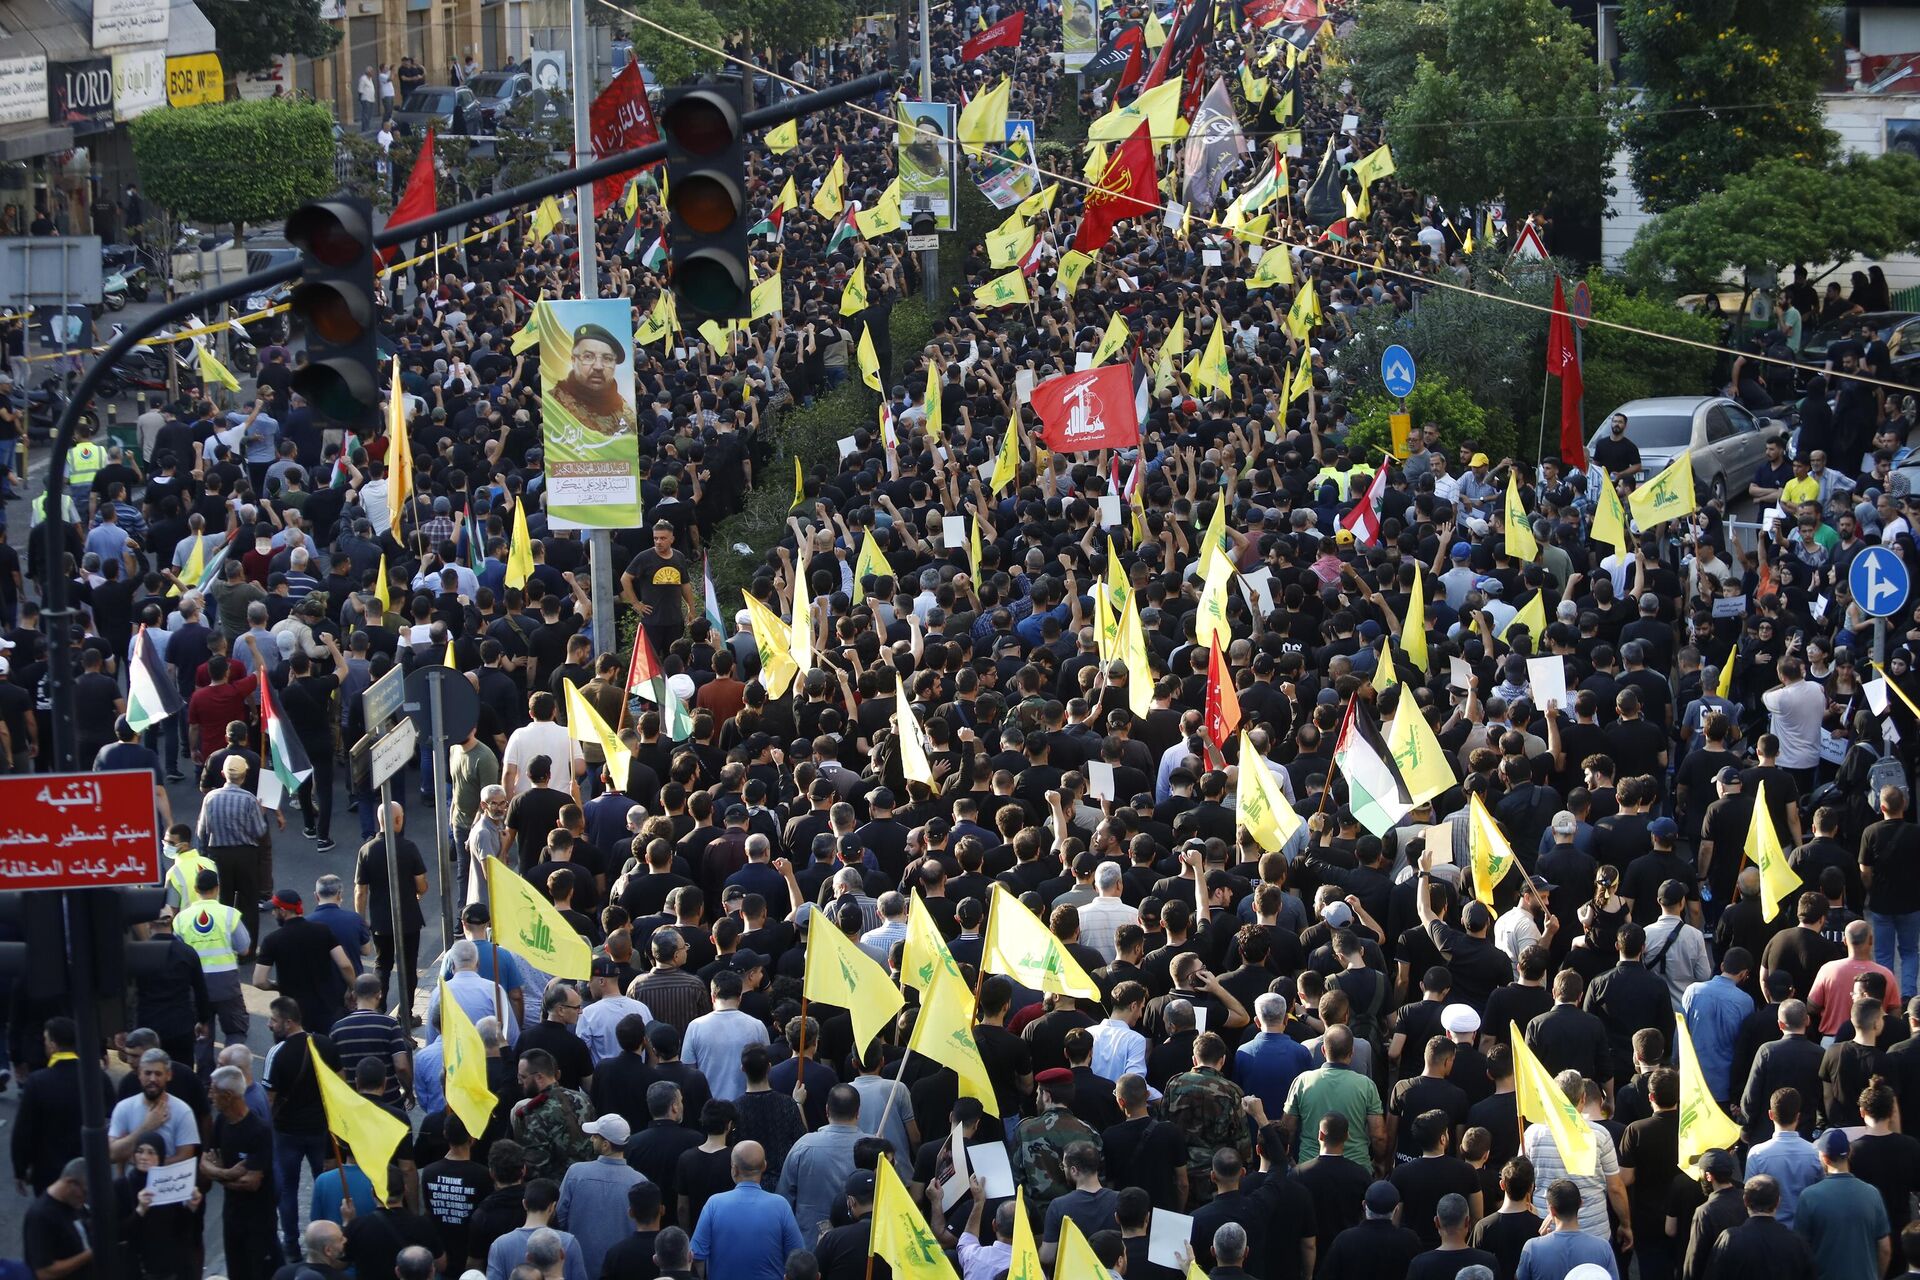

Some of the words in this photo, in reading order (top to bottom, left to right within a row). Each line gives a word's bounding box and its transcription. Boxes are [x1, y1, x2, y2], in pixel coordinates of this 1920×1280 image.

[65, 69, 112, 109] LORD
[36, 780, 102, 813] إنتبه
[0, 828, 49, 849] محاض
[55, 823, 107, 847] تسطير
[112, 823, 151, 847] سيتم
[69, 855, 147, 878] بالمركبات
[437, 1175, 441, 1183] I
[441, 1176, 462, 1185] THINK
[450, 1185, 463, 1194] GOT
[463, 1187, 475, 1195] ME
[432, 1191, 466, 1202] CONFUSED
[433, 1207, 449, 1216] THAT
[450, 1209, 469, 1218] GIVES
